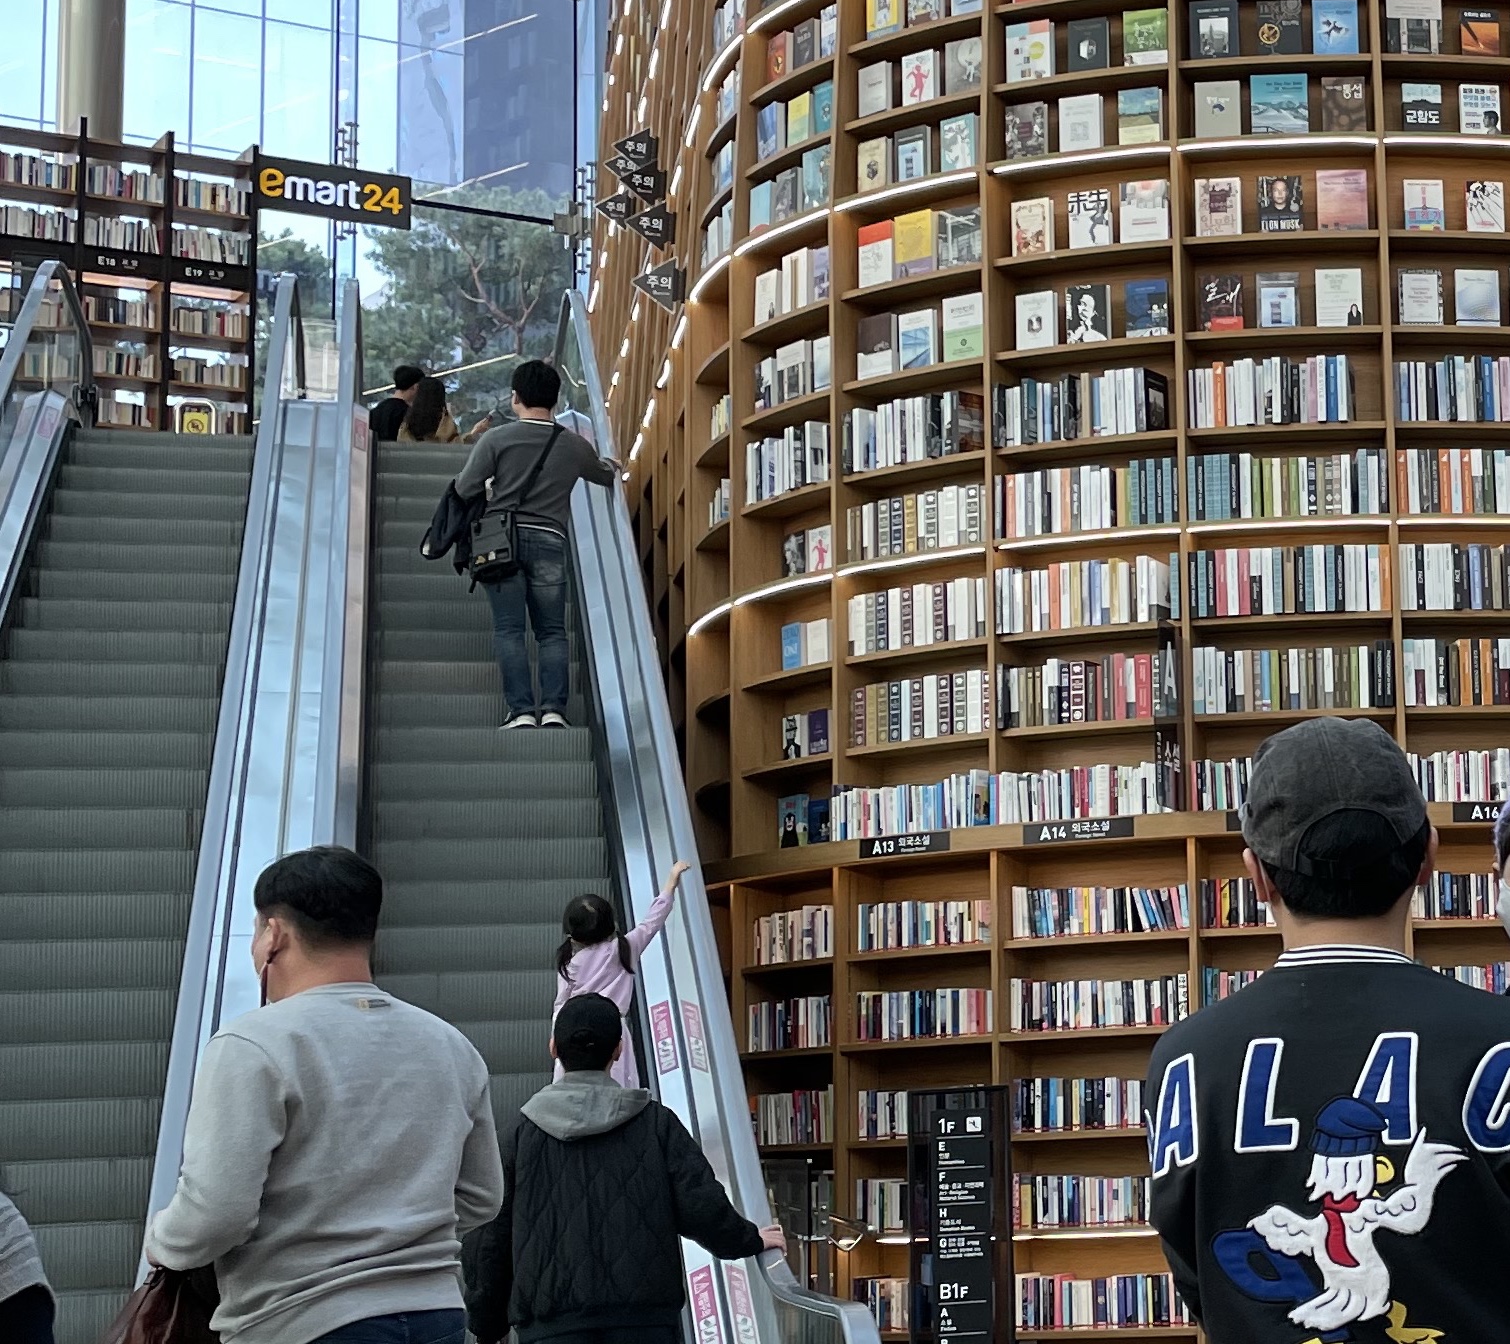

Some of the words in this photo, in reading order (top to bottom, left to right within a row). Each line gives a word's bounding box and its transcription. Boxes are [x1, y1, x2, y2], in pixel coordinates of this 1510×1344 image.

[1406, 109, 1440, 125] 군함도
[624, 139, 647, 155] 주의
[631, 173, 655, 189] 주의
[259, 167, 404, 217] emart24
[605, 201, 626, 214] 주의
[638, 216, 663, 230] 주의
[646, 275, 672, 291] 주의
[1164, 641, 1177, 699] A
[1039, 825, 1066, 841] A14
[1071, 820, 1110, 833] 외국소설
[872, 839, 895, 855] A13
[898, 834, 931, 847] 외국소설
[938, 1117, 956, 1134] 1F
[938, 1141, 946, 1151] E
[938, 1172, 946, 1182] F
[939, 1208, 948, 1218] H
[939, 1282, 969, 1300] B1F
[940, 1307, 949, 1318] A
